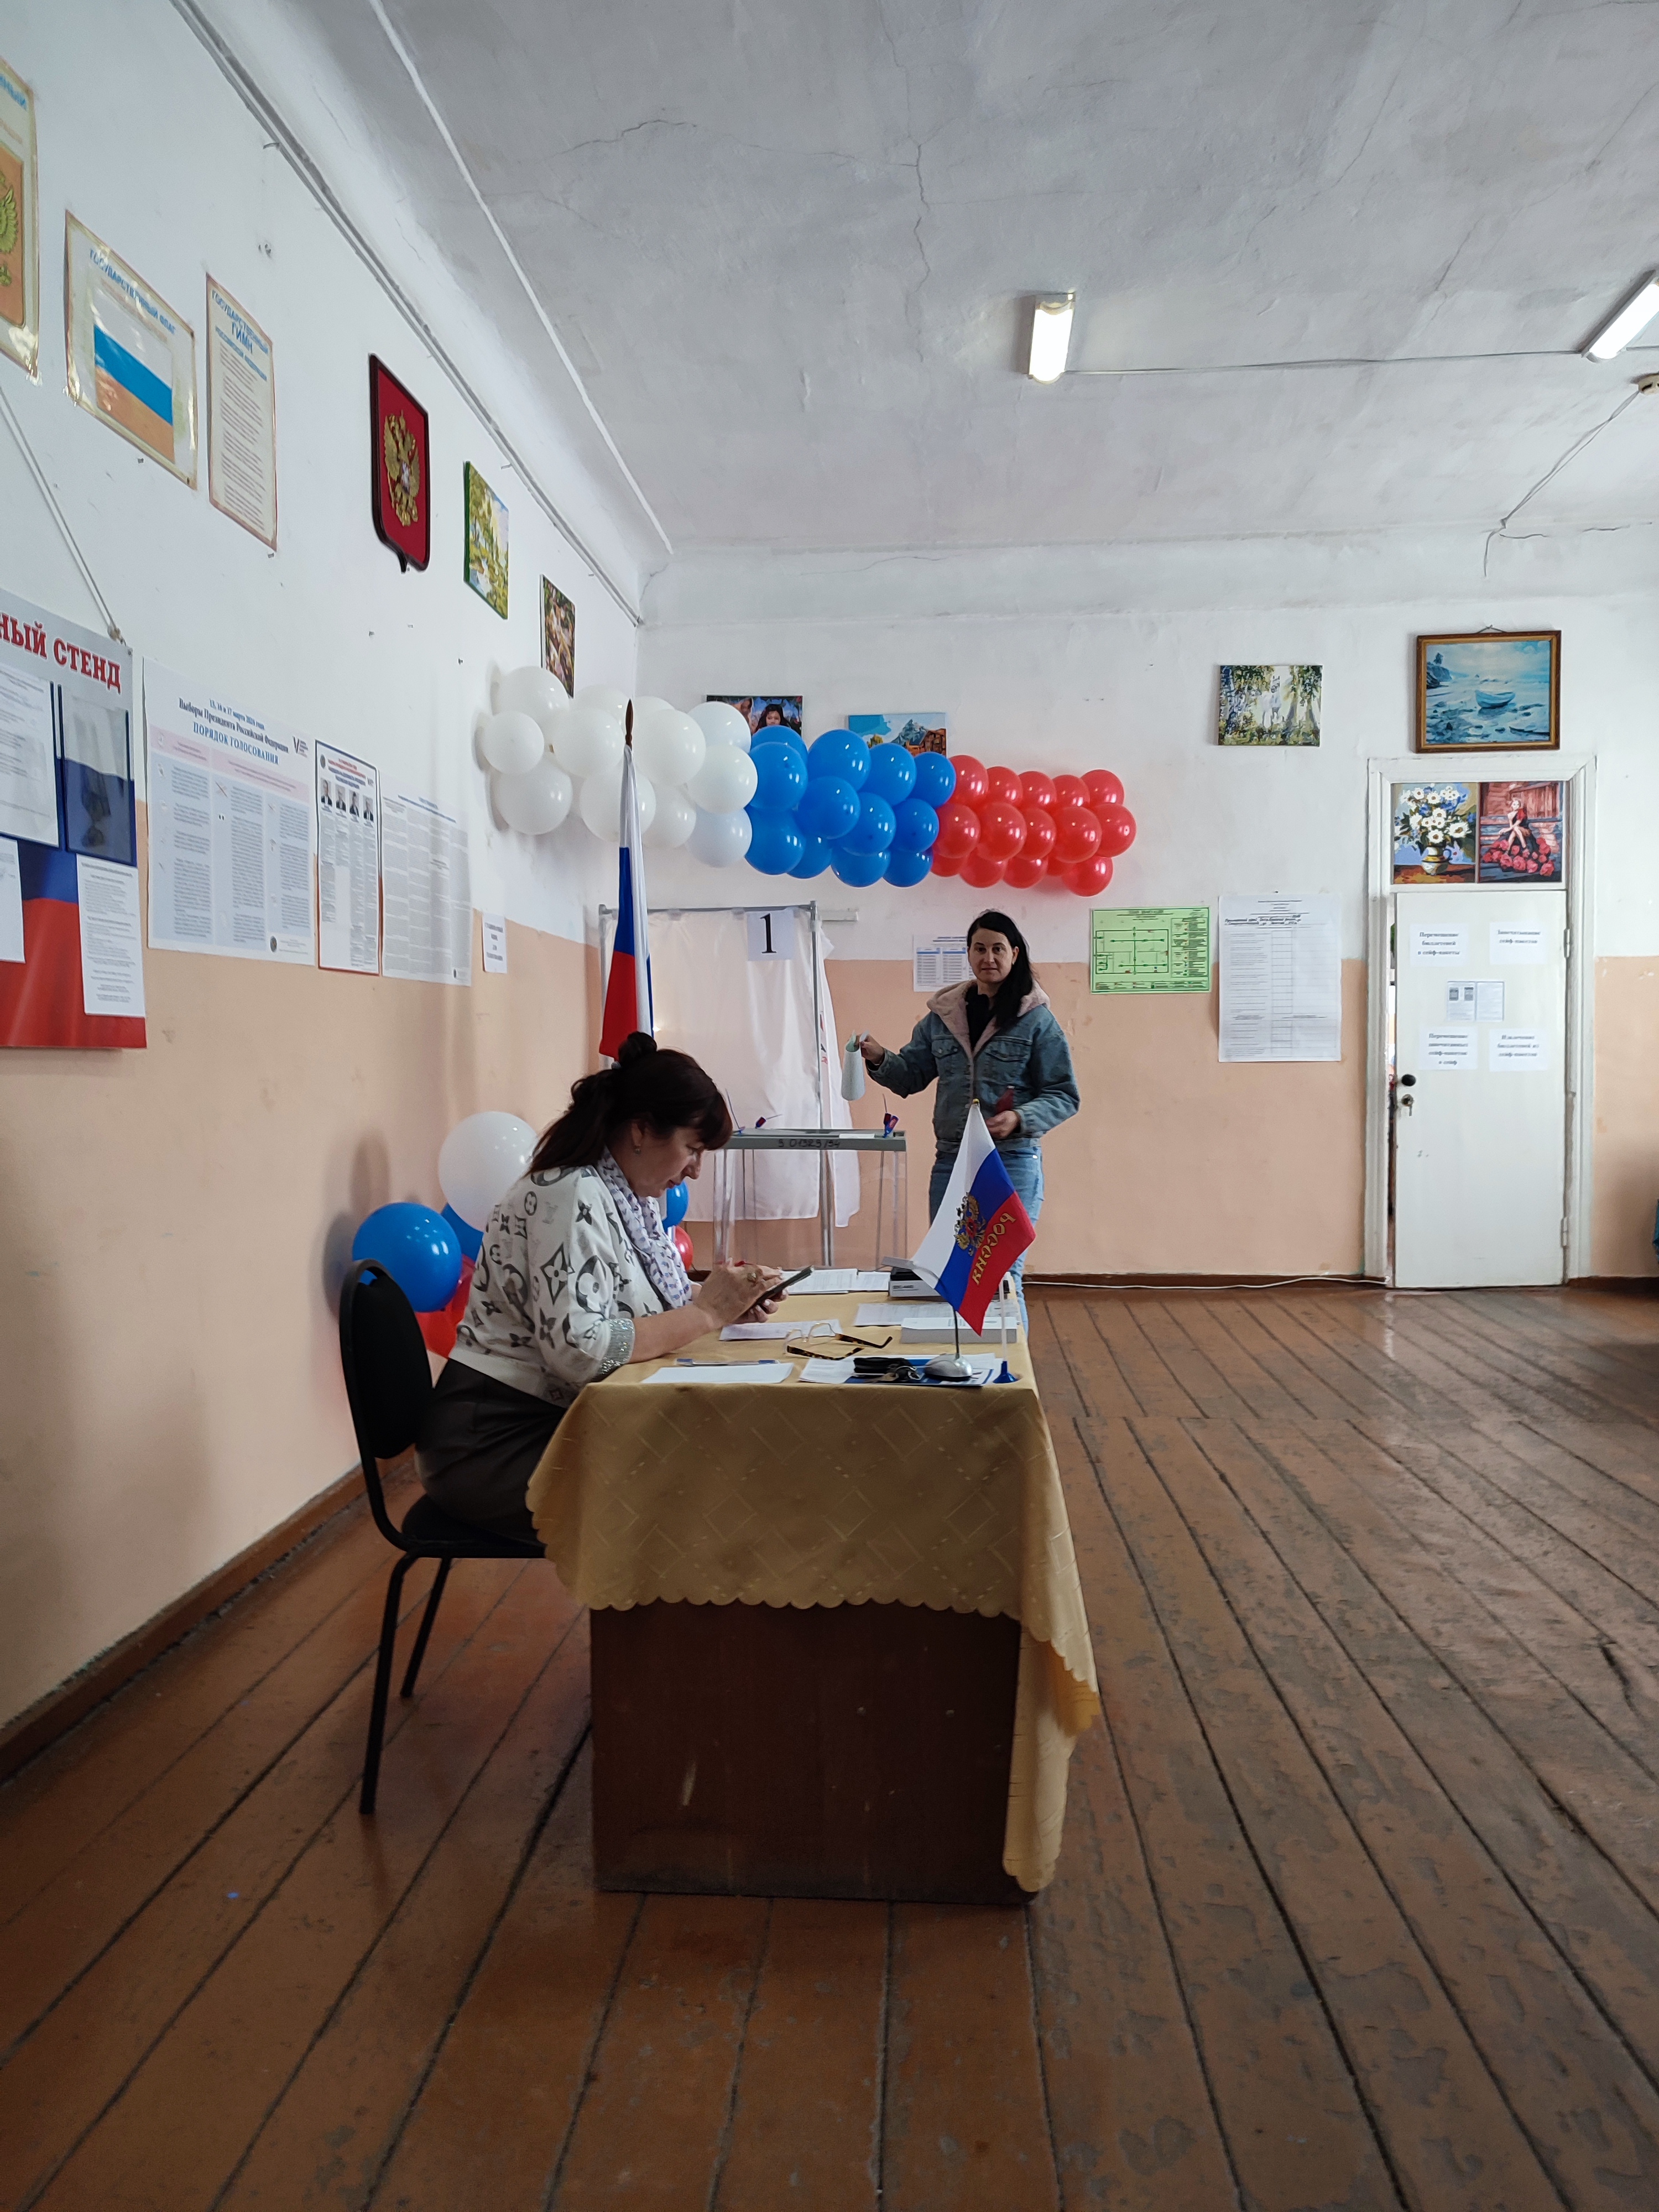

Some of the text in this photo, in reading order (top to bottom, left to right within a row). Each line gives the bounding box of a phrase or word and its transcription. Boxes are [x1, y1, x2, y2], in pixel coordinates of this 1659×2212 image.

[232, 321, 253, 354] ГИМН
[54, 638, 121, 695] СТЕНД
[179, 697, 289, 753] Выборы Президента Российской Федерации
[194, 721, 228, 745] ПОРЯДОК
[230, 736, 279, 765] ГОЛОСОВАНИЯ
[760, 912, 777, 954] 1
